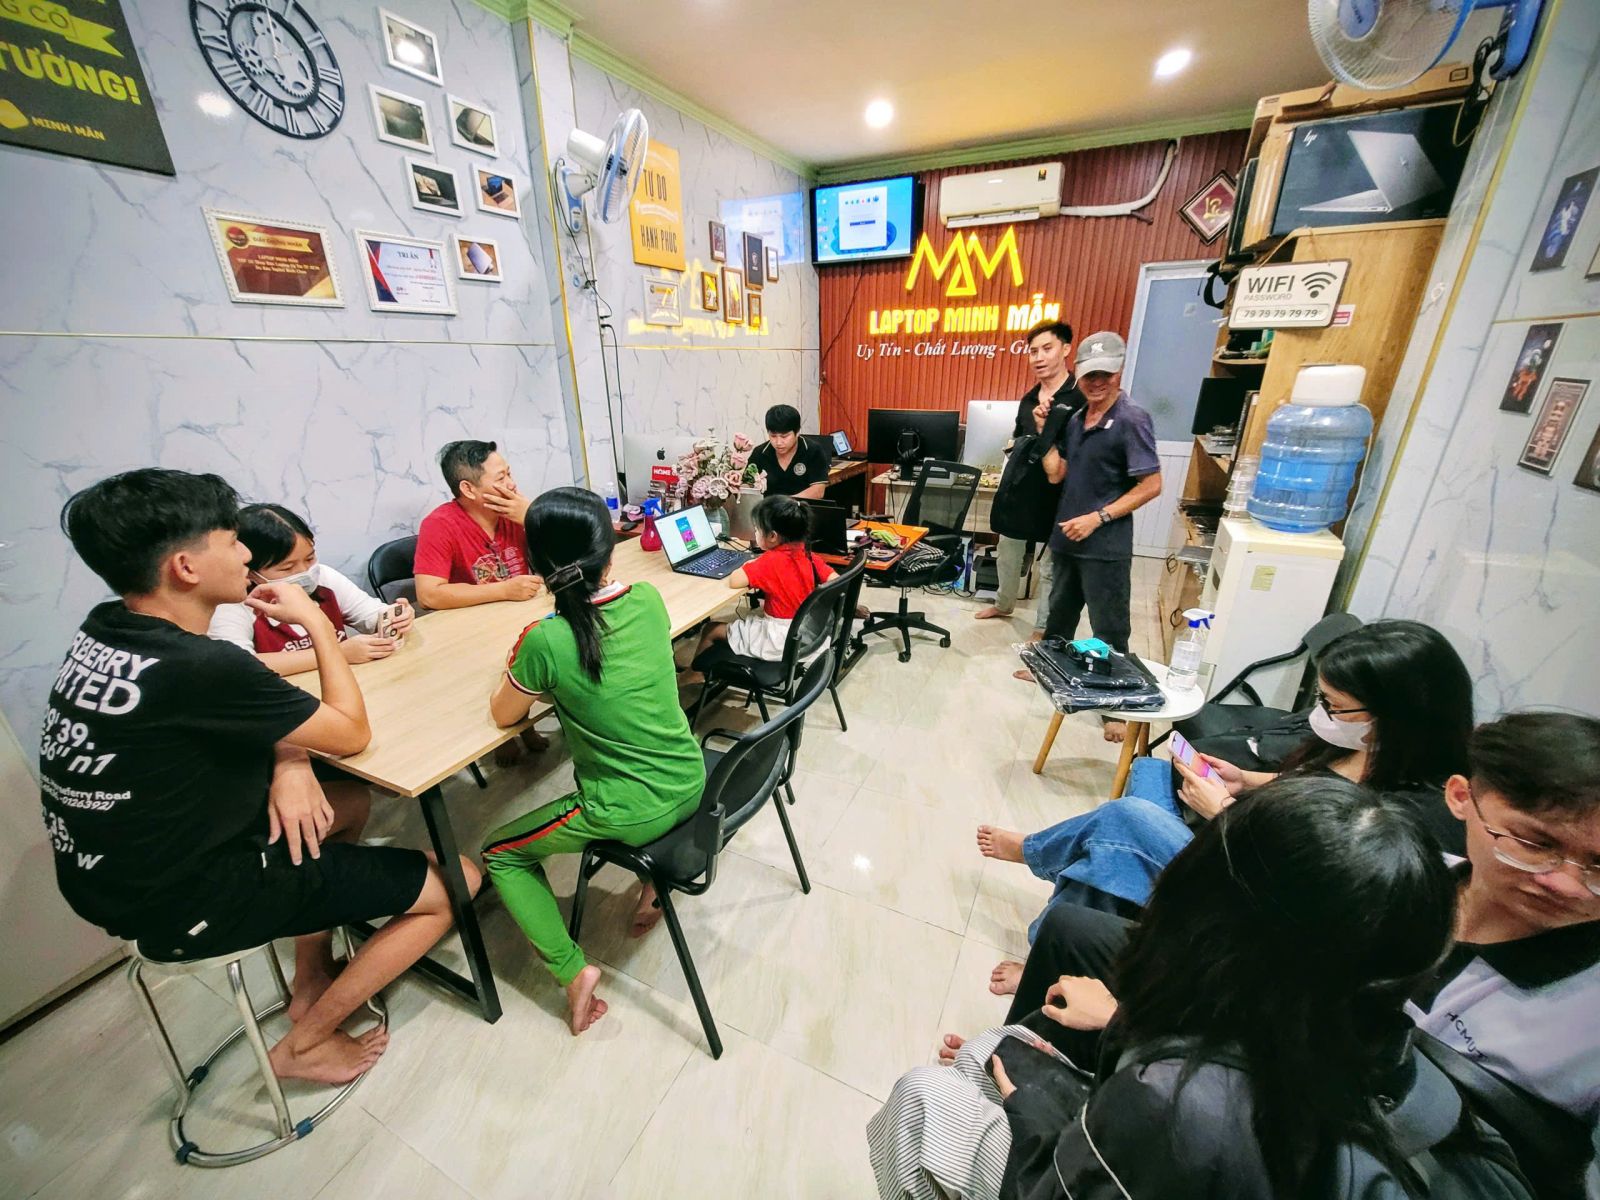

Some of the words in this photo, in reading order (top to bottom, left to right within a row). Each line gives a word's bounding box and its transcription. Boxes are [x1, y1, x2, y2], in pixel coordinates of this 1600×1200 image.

[31, 116, 72, 134] MINH
[640, 224, 659, 252] HẠNH
[1248, 275, 1296, 293] WIFI
[1243, 293, 1293, 302] PASSWORD
[869, 308, 940, 335] LAPTOP
[943, 305, 1000, 333] MINH
[1244, 309, 1256, 318] 79
[1259, 309, 1271, 318] 79
[1273, 309, 1286, 318] 79
[1289, 309, 1302, 318] 79
[856, 343, 875, 361] Uy
[879, 342, 901, 357] Tín
[914, 338, 945, 356] Chất
[951, 341, 997, 360] Lượng
[95, 790, 131, 800] Road
[1444, 1012, 1488, 1060] HCMUT
